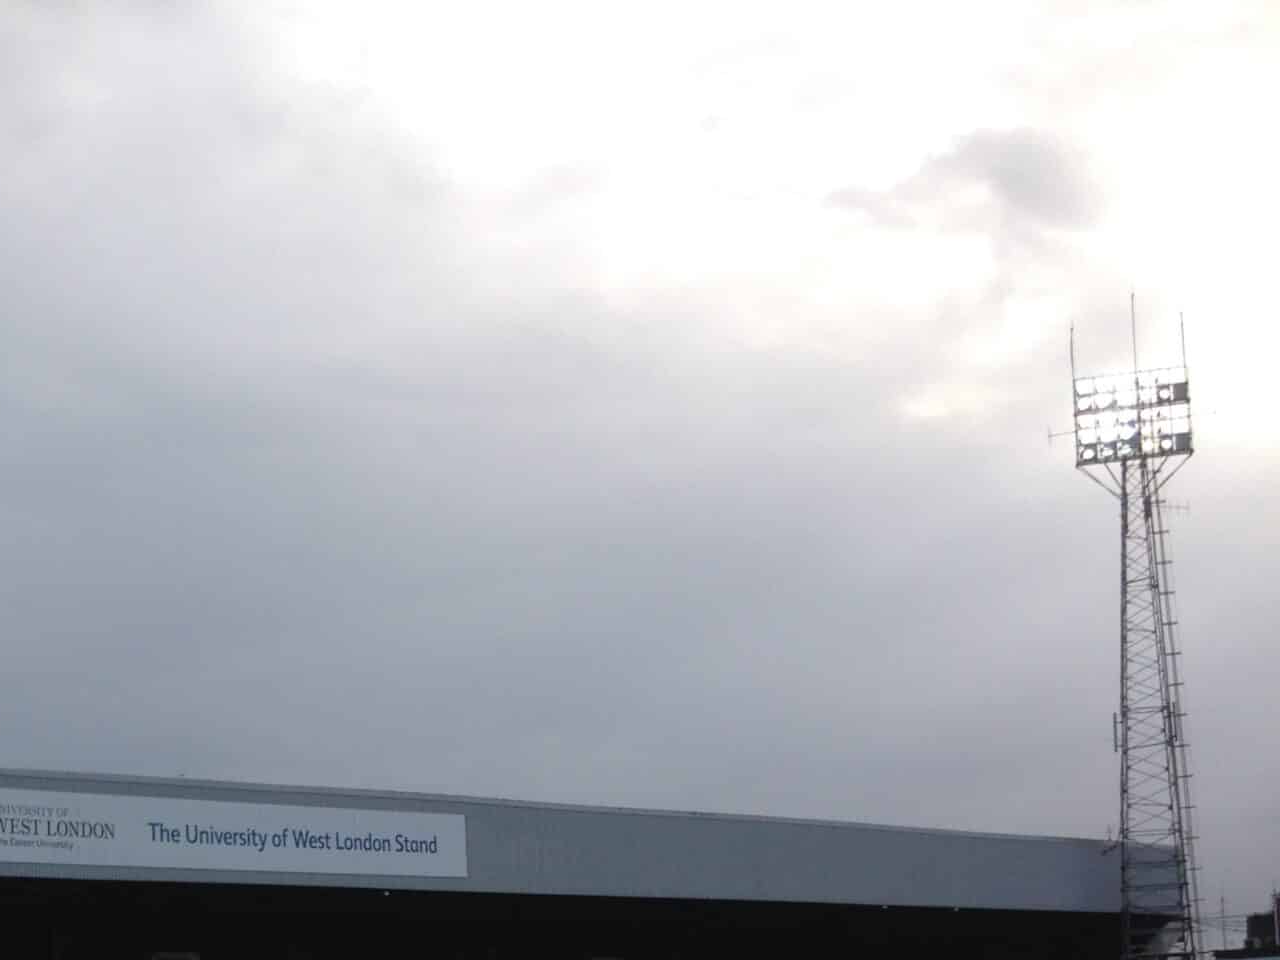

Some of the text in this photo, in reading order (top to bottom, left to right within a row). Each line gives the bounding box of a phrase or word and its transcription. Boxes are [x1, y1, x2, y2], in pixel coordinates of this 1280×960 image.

[47, 820, 117, 841] LONDON
[148, 822, 437, 856] The University of West London Stand
